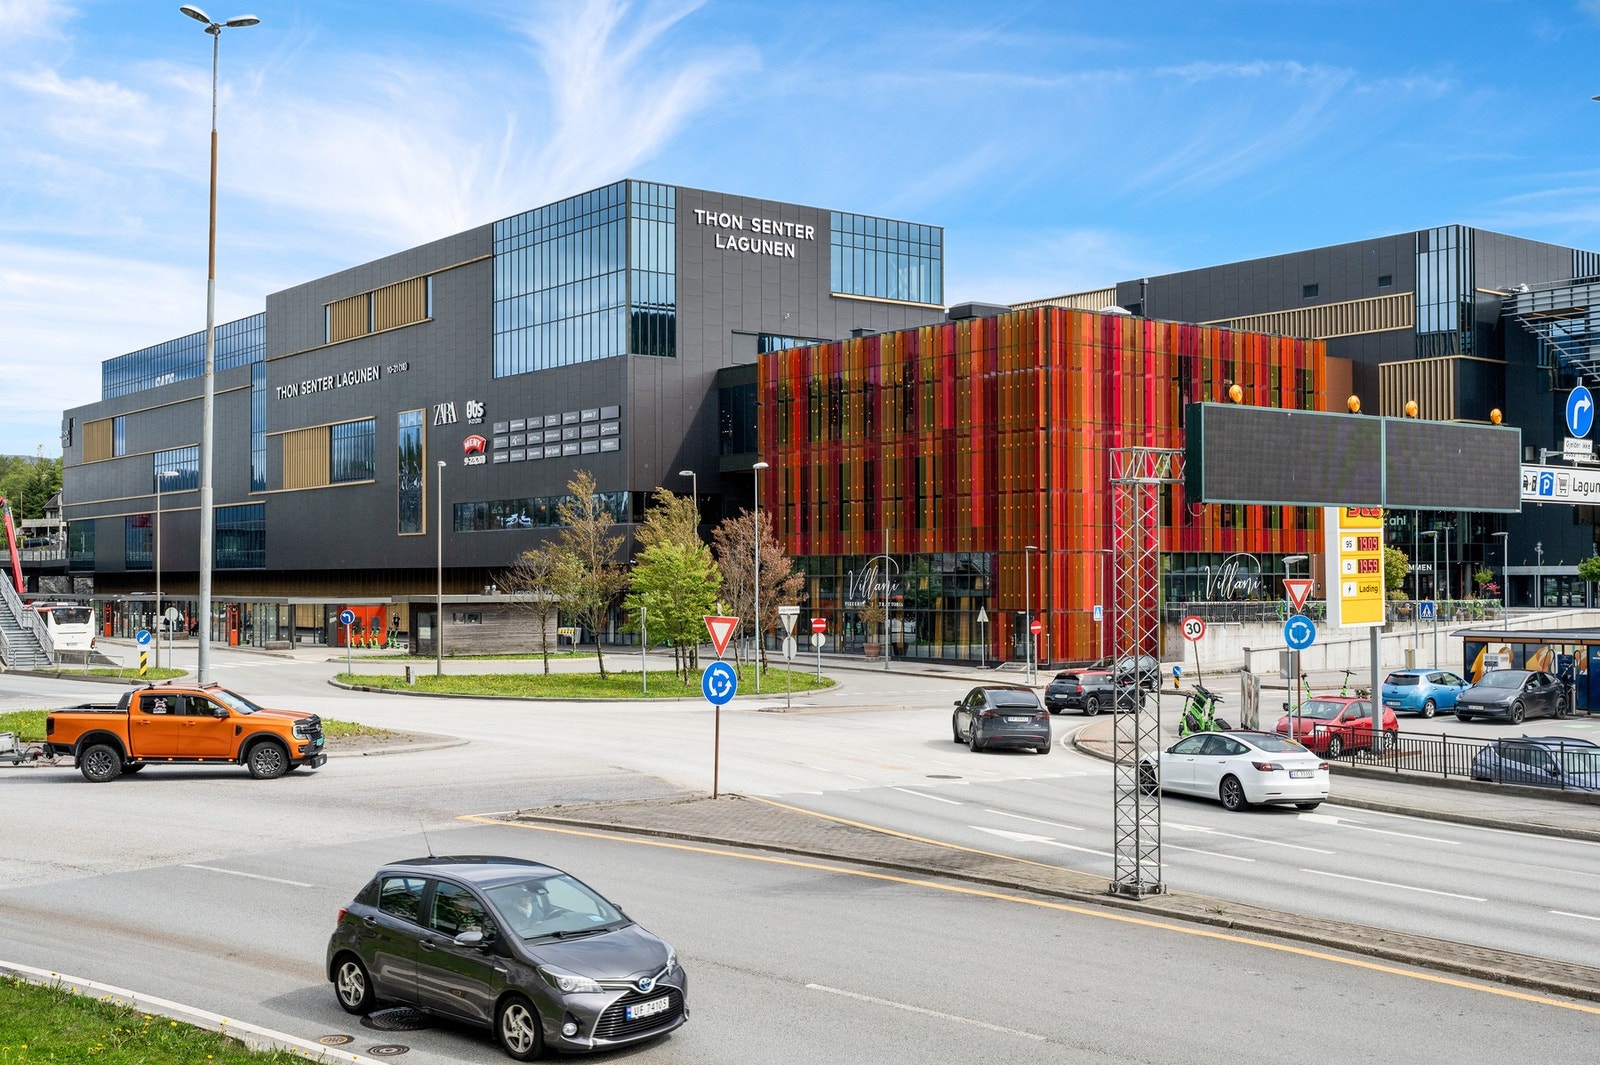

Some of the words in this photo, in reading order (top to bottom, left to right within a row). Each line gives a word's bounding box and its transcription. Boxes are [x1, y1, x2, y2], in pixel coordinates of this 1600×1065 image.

[694, 209, 743, 230] THON
[751, 218, 814, 240] SENTER
[715, 233, 795, 258] LAGUNEN
[276, 382, 299, 400] THON
[301, 375, 334, 396] SENTER
[336, 365, 380, 388] LAGUNEN
[433, 401, 459, 426] ZARA
[464, 437, 482, 450] MENY
[1573, 477, 1600, 496] Lagun
[1345, 540, 1353, 549] 95
[1359, 537, 1378, 551] 19.09
[1346, 563, 1352, 571] D
[1359, 559, 1378, 573] 19.59
[1205, 553, 1261, 600] Villani
[1359, 585, 1379, 594] Lading
[1186, 621, 1202, 635] 30
[634, 1005, 643, 1016] UF
[647, 999, 667, 1013] 74105
